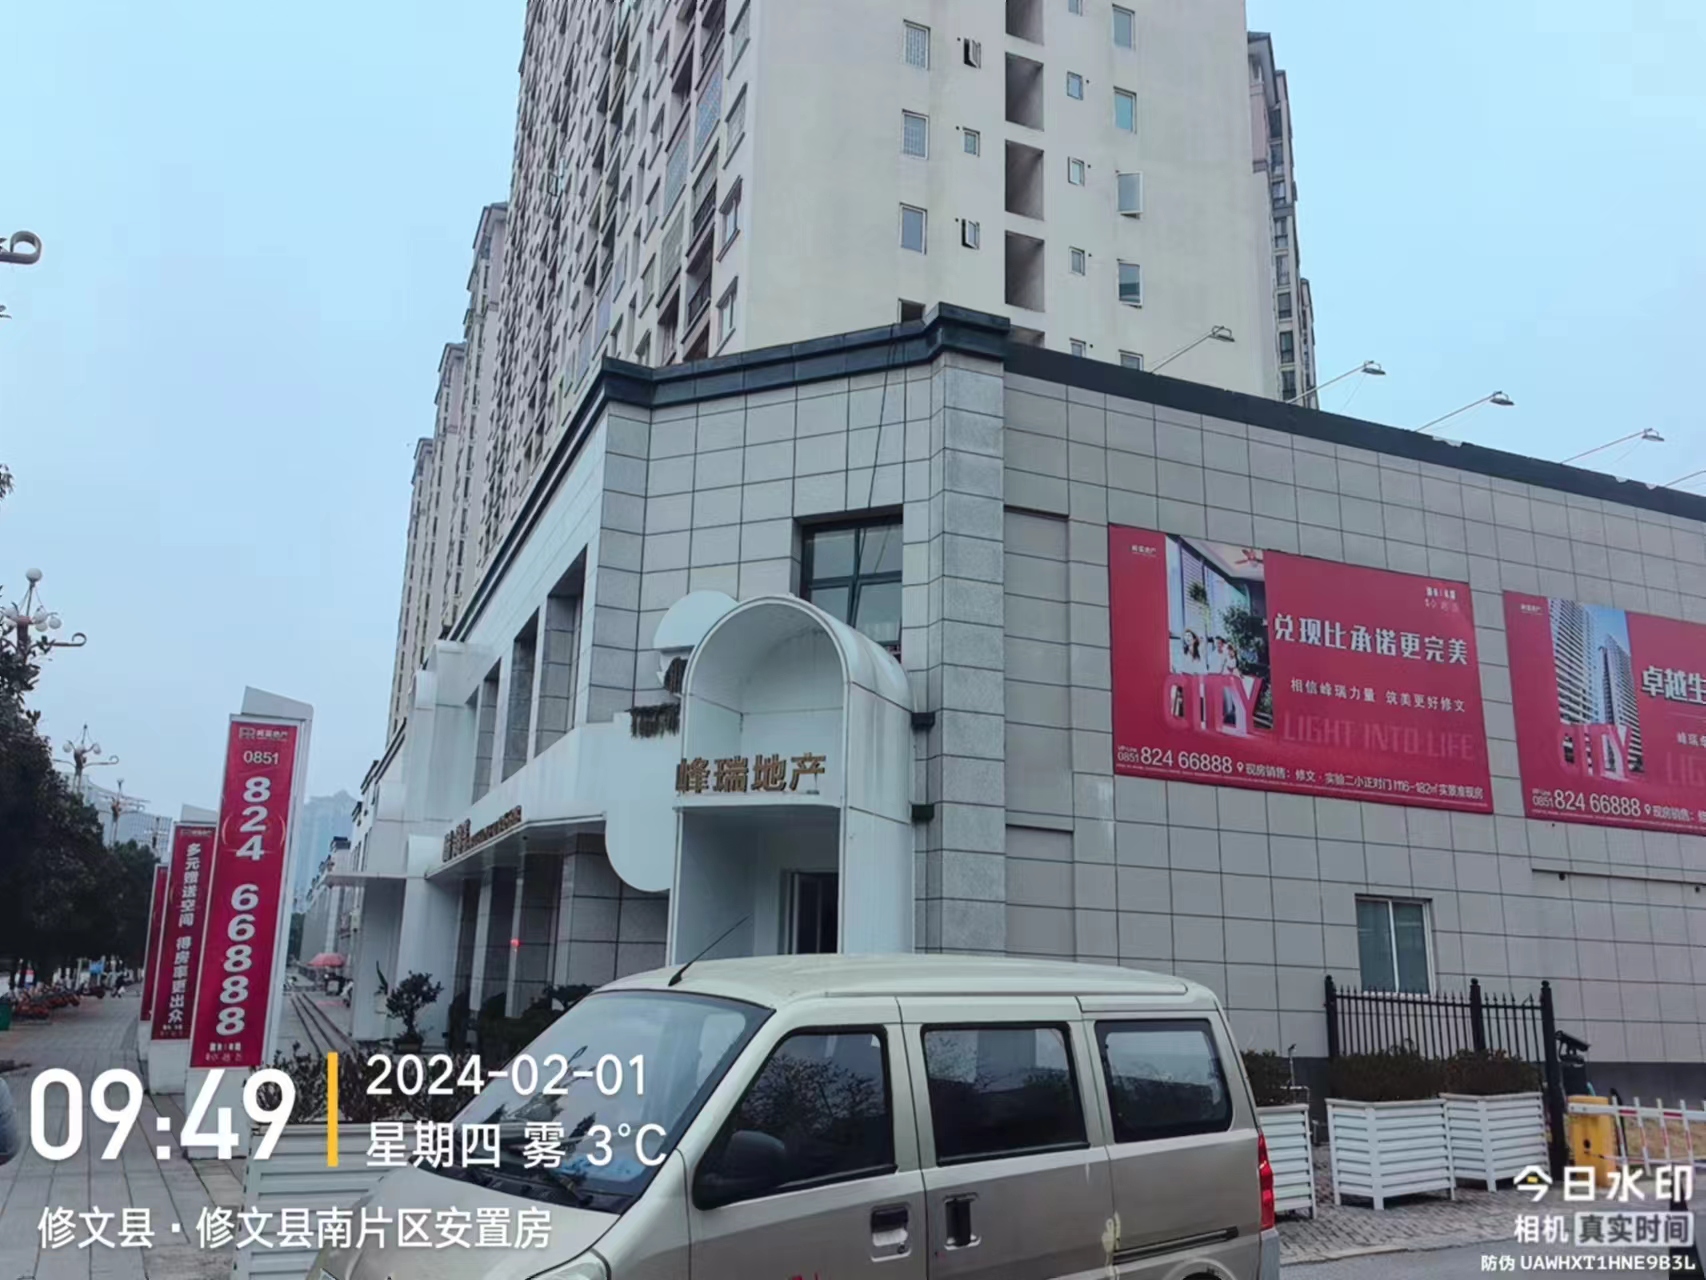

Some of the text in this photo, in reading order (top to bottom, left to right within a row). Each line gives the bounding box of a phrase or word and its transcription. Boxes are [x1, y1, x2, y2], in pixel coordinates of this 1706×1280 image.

[1274, 613, 1468, 665] 兑现比承诺更完美
[1291, 679, 1466, 713] 相信峰瑞力量 筑美更好修文
[1283, 712, 1476, 761] LIGHT INTO LIFE
[243, 750, 279, 765] 0851
[675, 752, 827, 794] 峰瑞地产
[1140, 746, 1174, 767] 824
[1178, 751, 1233, 774] 66888
[1554, 789, 1586, 811] 824
[1589, 793, 1642, 817] 66888
